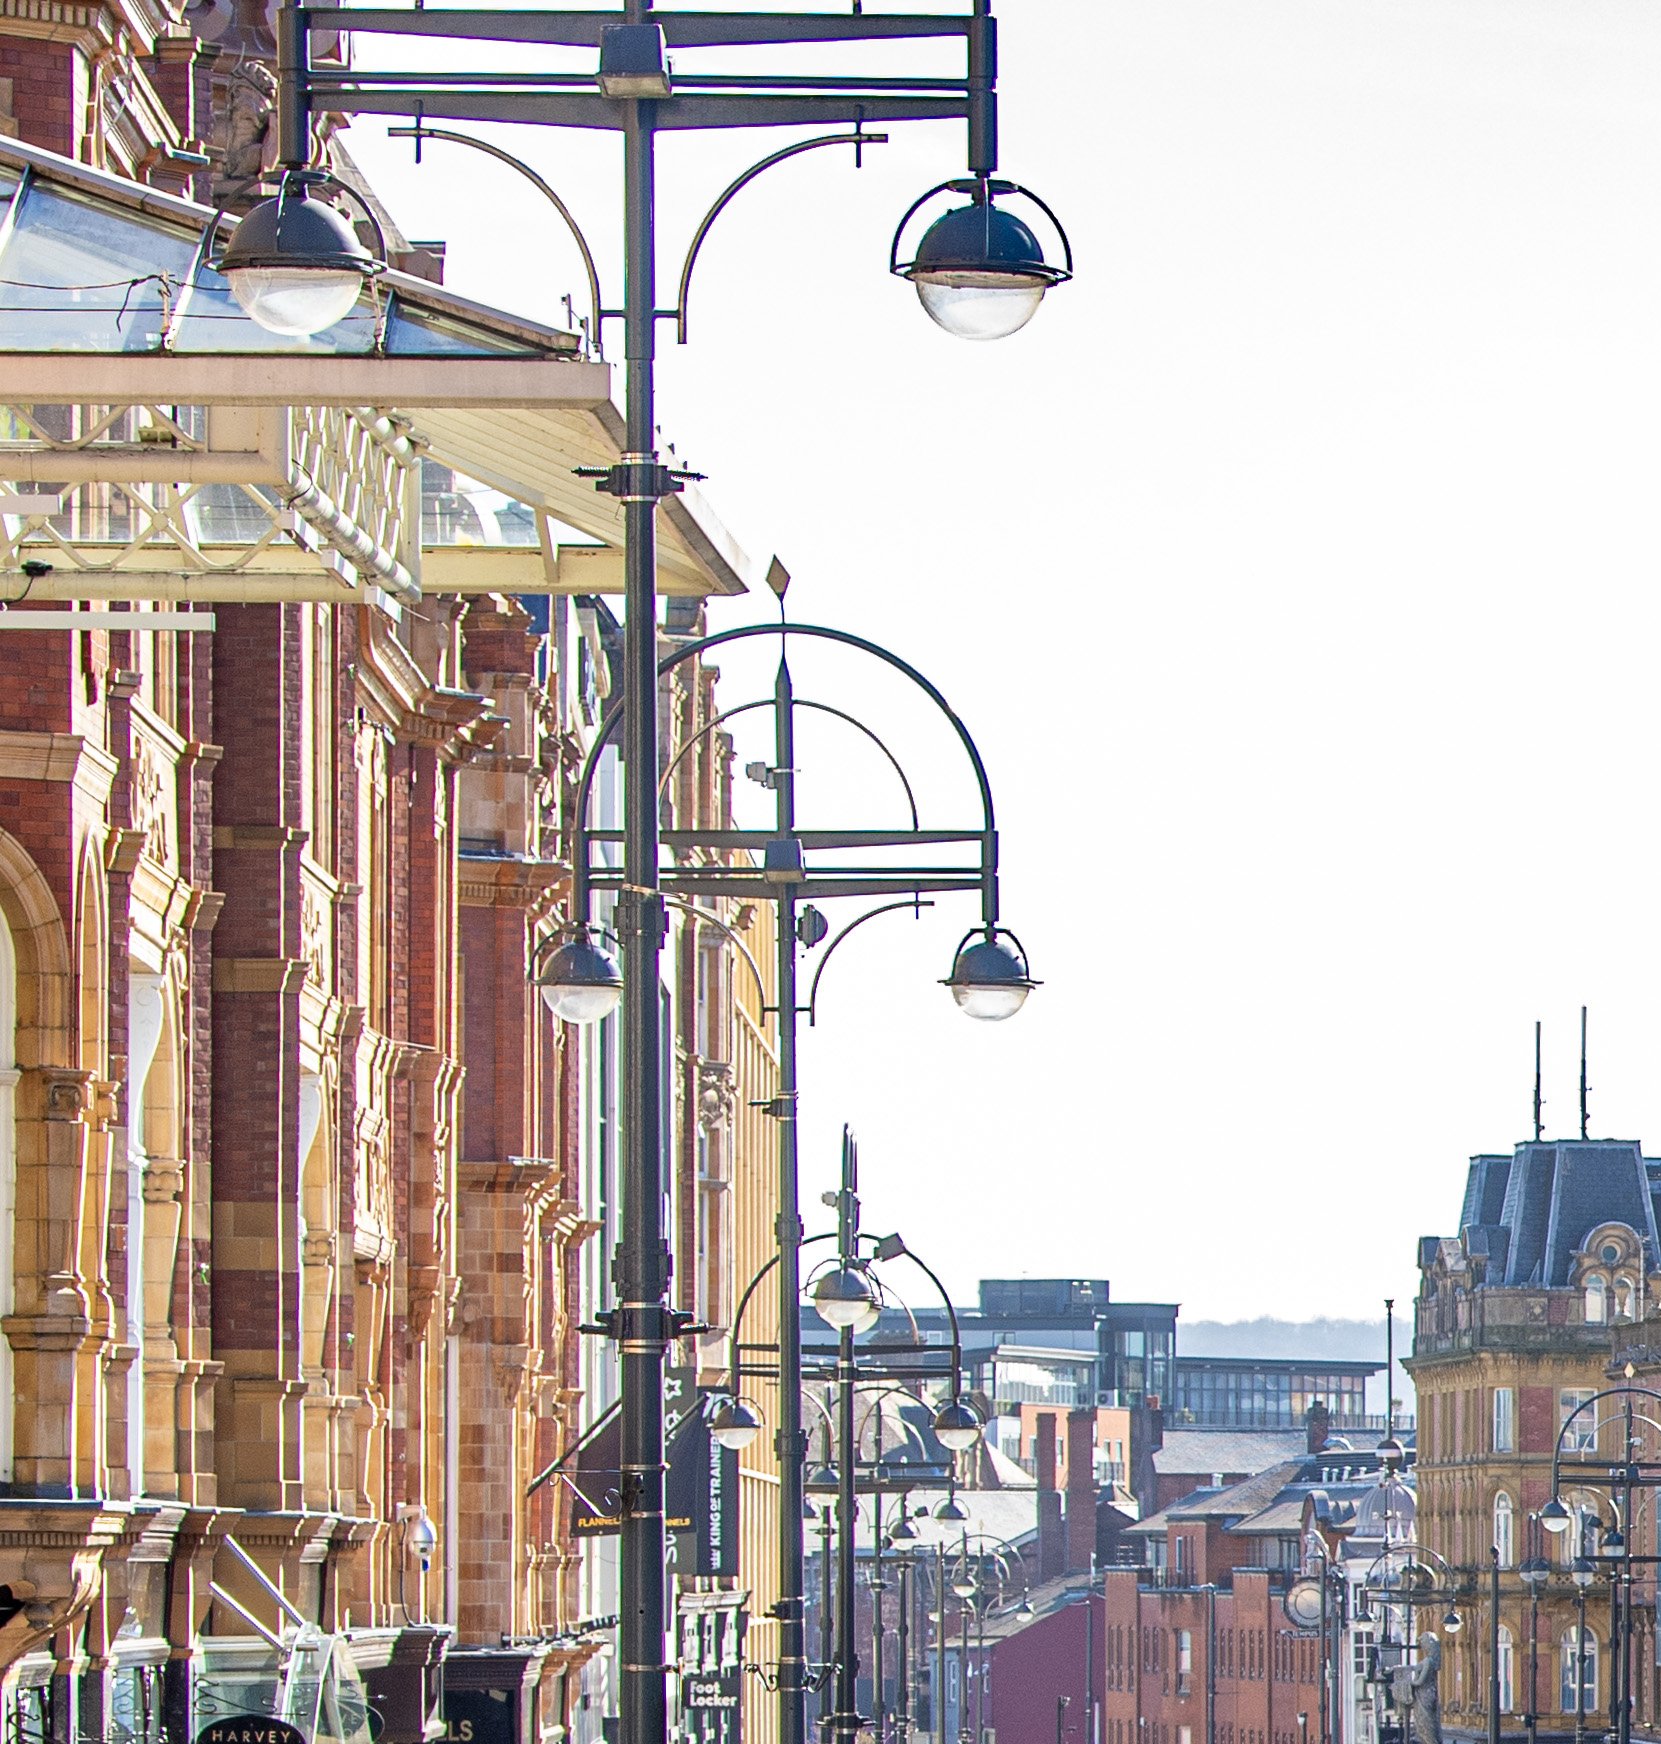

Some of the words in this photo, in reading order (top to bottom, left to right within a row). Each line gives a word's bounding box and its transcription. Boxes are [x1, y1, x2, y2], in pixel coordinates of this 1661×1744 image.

[709, 1515, 721, 1547] KING
[690, 1680, 721, 1694] Foot
[690, 1694, 738, 1707] Locker
[212, 1729, 291, 1744] HARVEY
